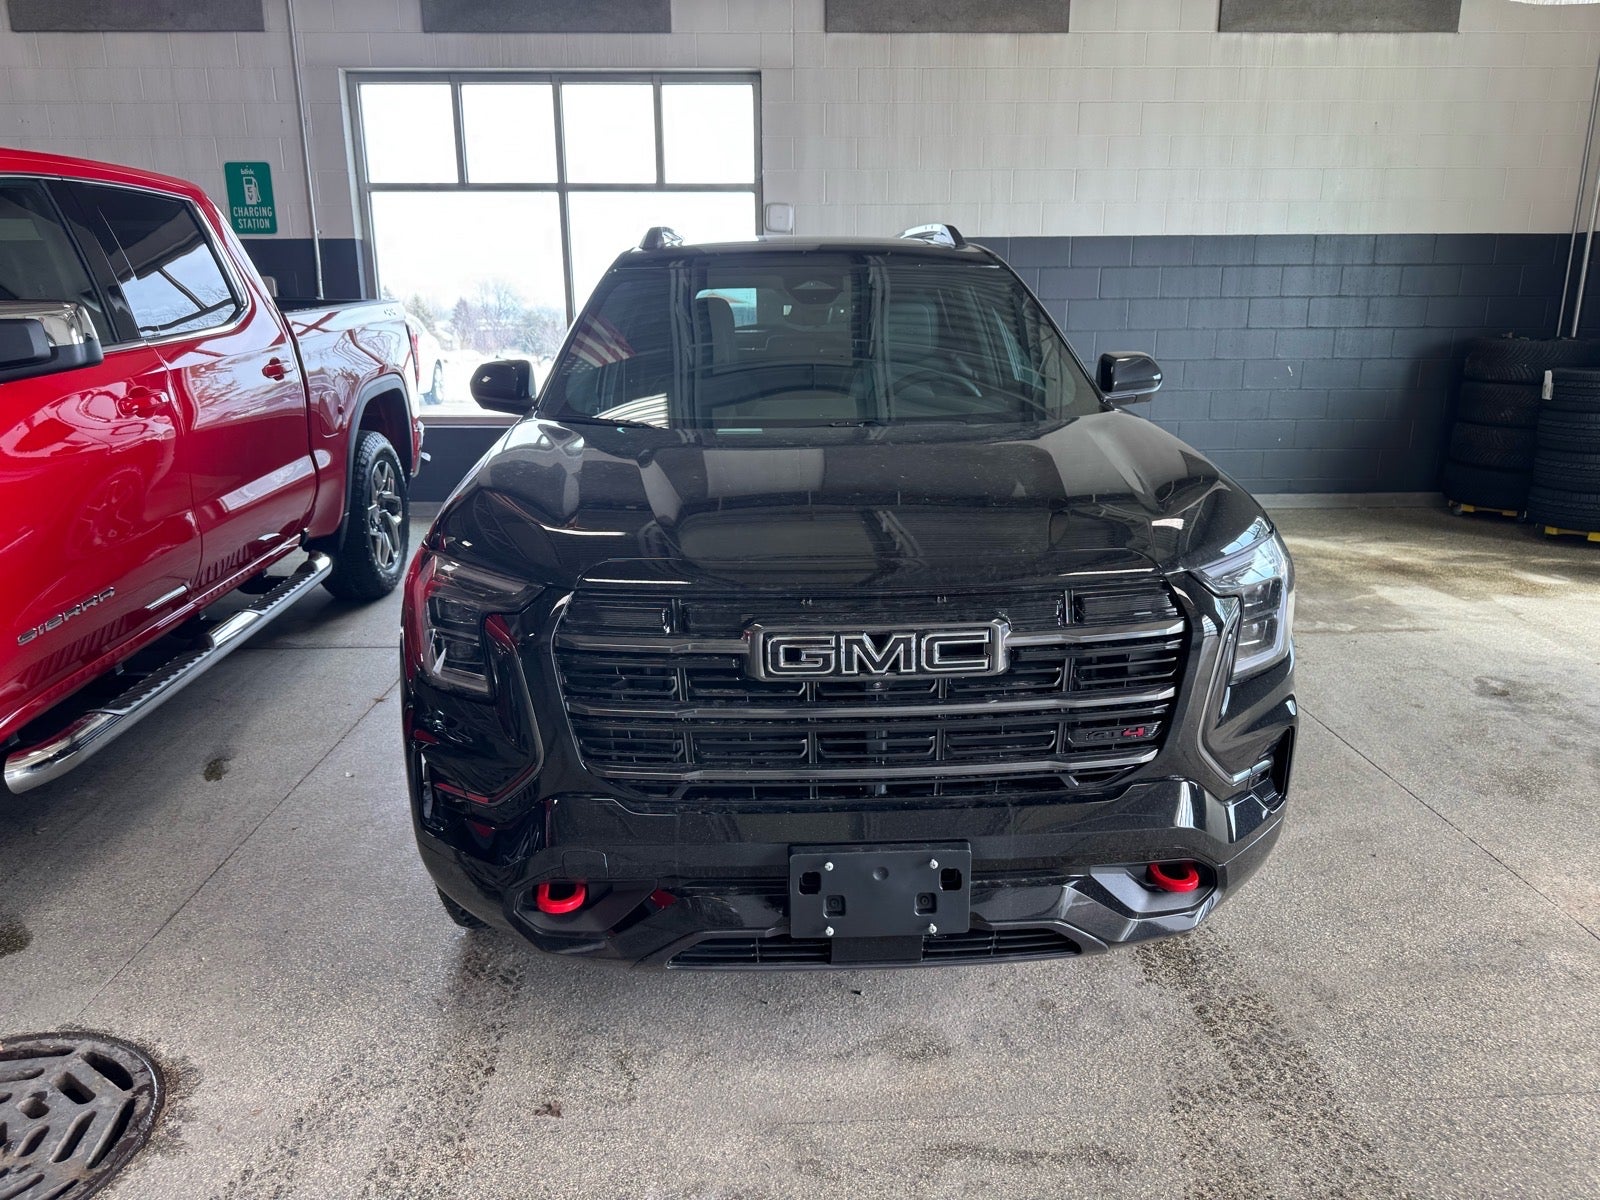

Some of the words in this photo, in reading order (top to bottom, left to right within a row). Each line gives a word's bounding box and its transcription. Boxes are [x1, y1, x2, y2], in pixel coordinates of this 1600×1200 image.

[233, 206, 273, 217] CHARGING
[238, 218, 271, 230] STATION
[17, 586, 115, 646] SIERRA
[767, 628, 990, 676] GMC
